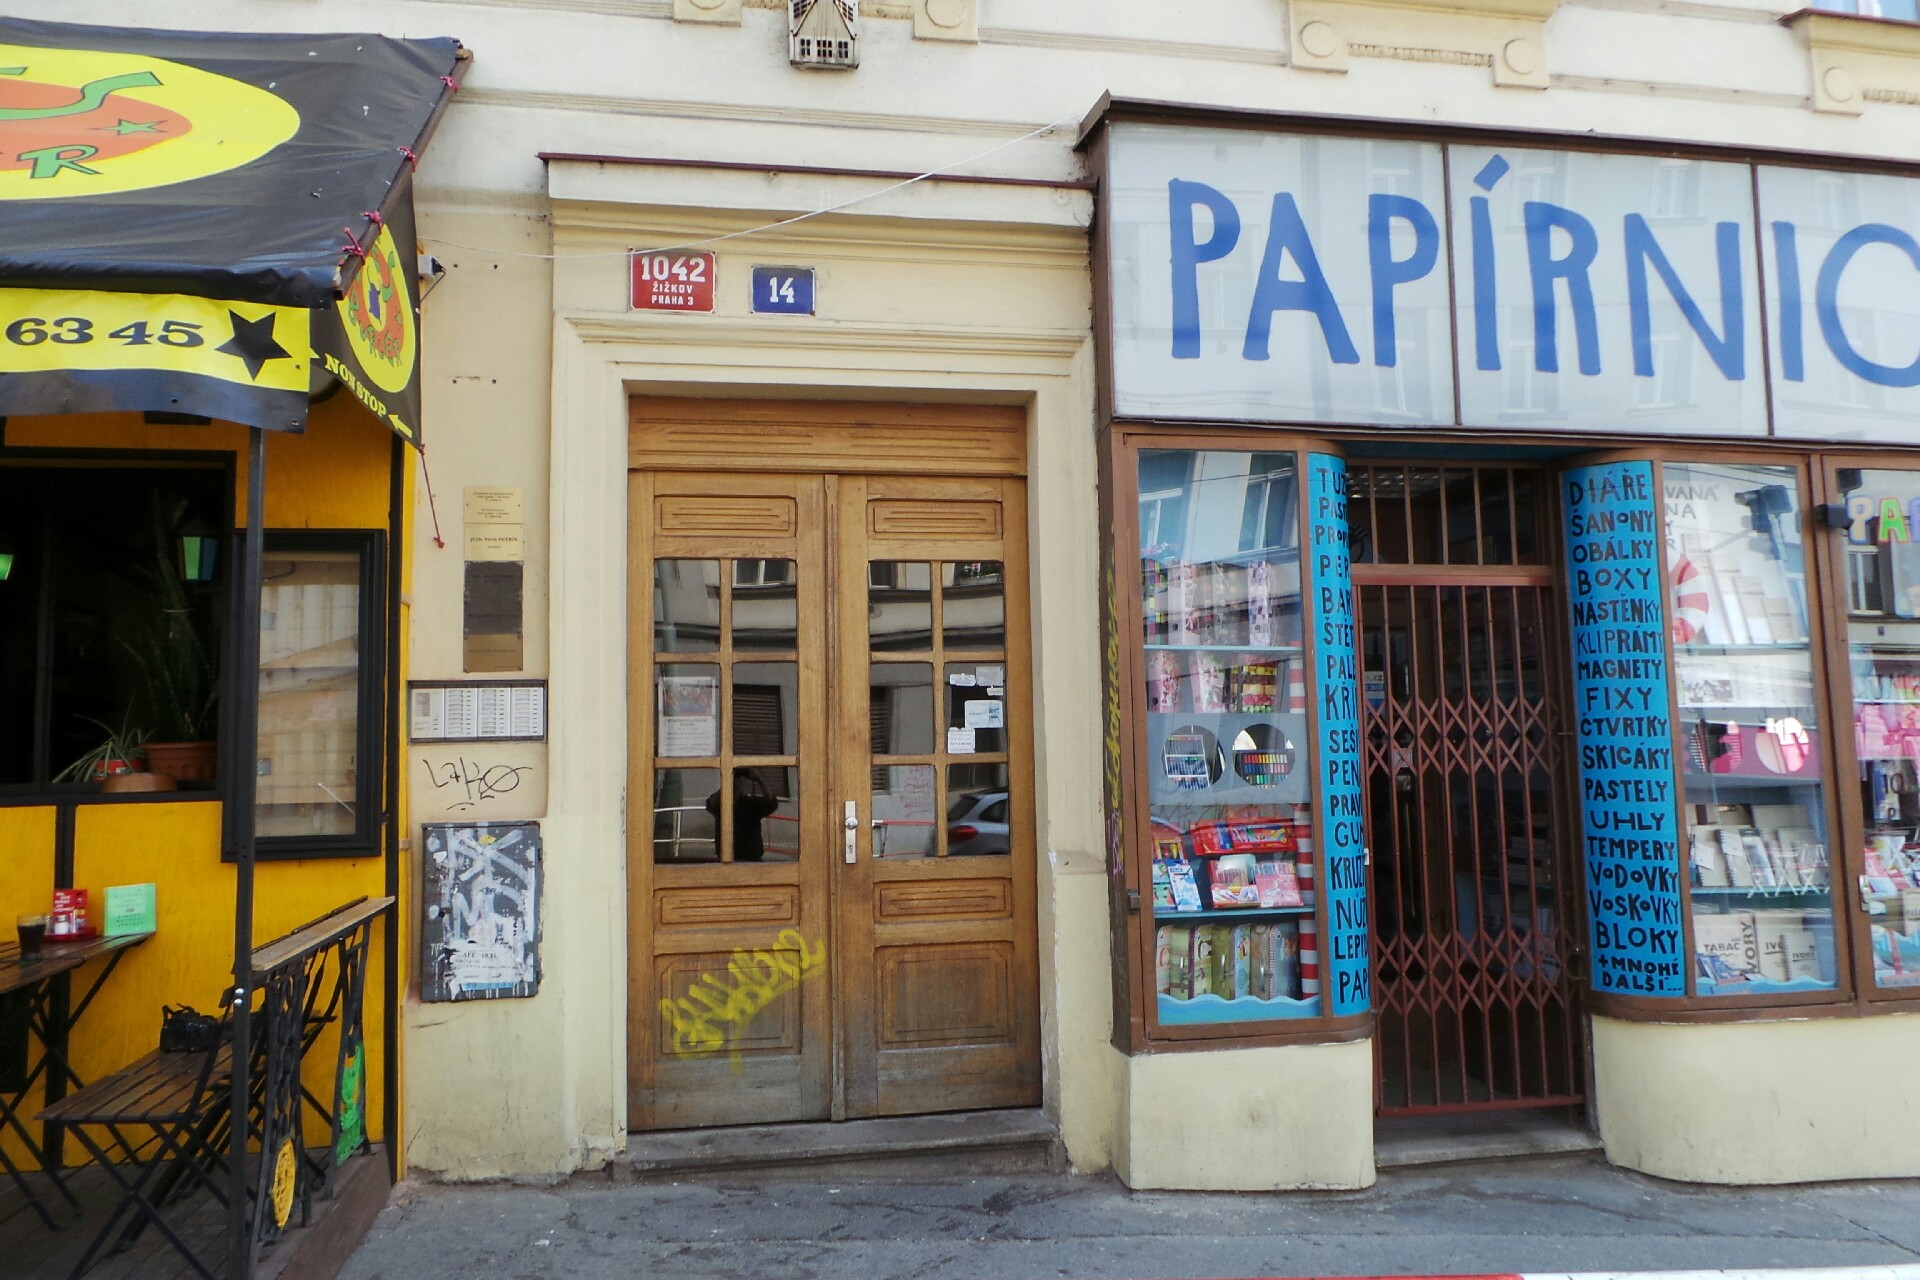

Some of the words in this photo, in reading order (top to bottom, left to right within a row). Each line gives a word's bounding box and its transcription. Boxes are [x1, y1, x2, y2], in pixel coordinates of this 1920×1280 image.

[641, 256, 706, 282] 1042
[651, 295, 684, 305] PRAHA
[687, 296, 694, 306] 3
[652, 281, 693, 294] ŽIŽKOV
[769, 277, 795, 303] 14
[356, 381, 387, 418] STOP
[1569, 468, 1648, 506] DIÁŘE
[1571, 508, 1654, 537] ŠANONY
[1572, 536, 1653, 563] OBÁLKY
[1577, 567, 1651, 596] BOXY
[1573, 593, 1660, 626] NÁSTĚNKY
[1577, 659, 1662, 681] MAGNETY
[1585, 687, 1652, 712] FIXY
[1580, 712, 1667, 738] ČTVRTKY
[1582, 742, 1670, 770] SKICÁKY
[1584, 778, 1668, 802] PASTELY
[1590, 810, 1665, 831] UHLY
[1586, 836, 1675, 861] TEMPERY
[1589, 861, 1678, 893] VODOVKY
[1589, 890, 1679, 925] VOSKOVKY
[1596, 920, 1678, 954] BLOKY
